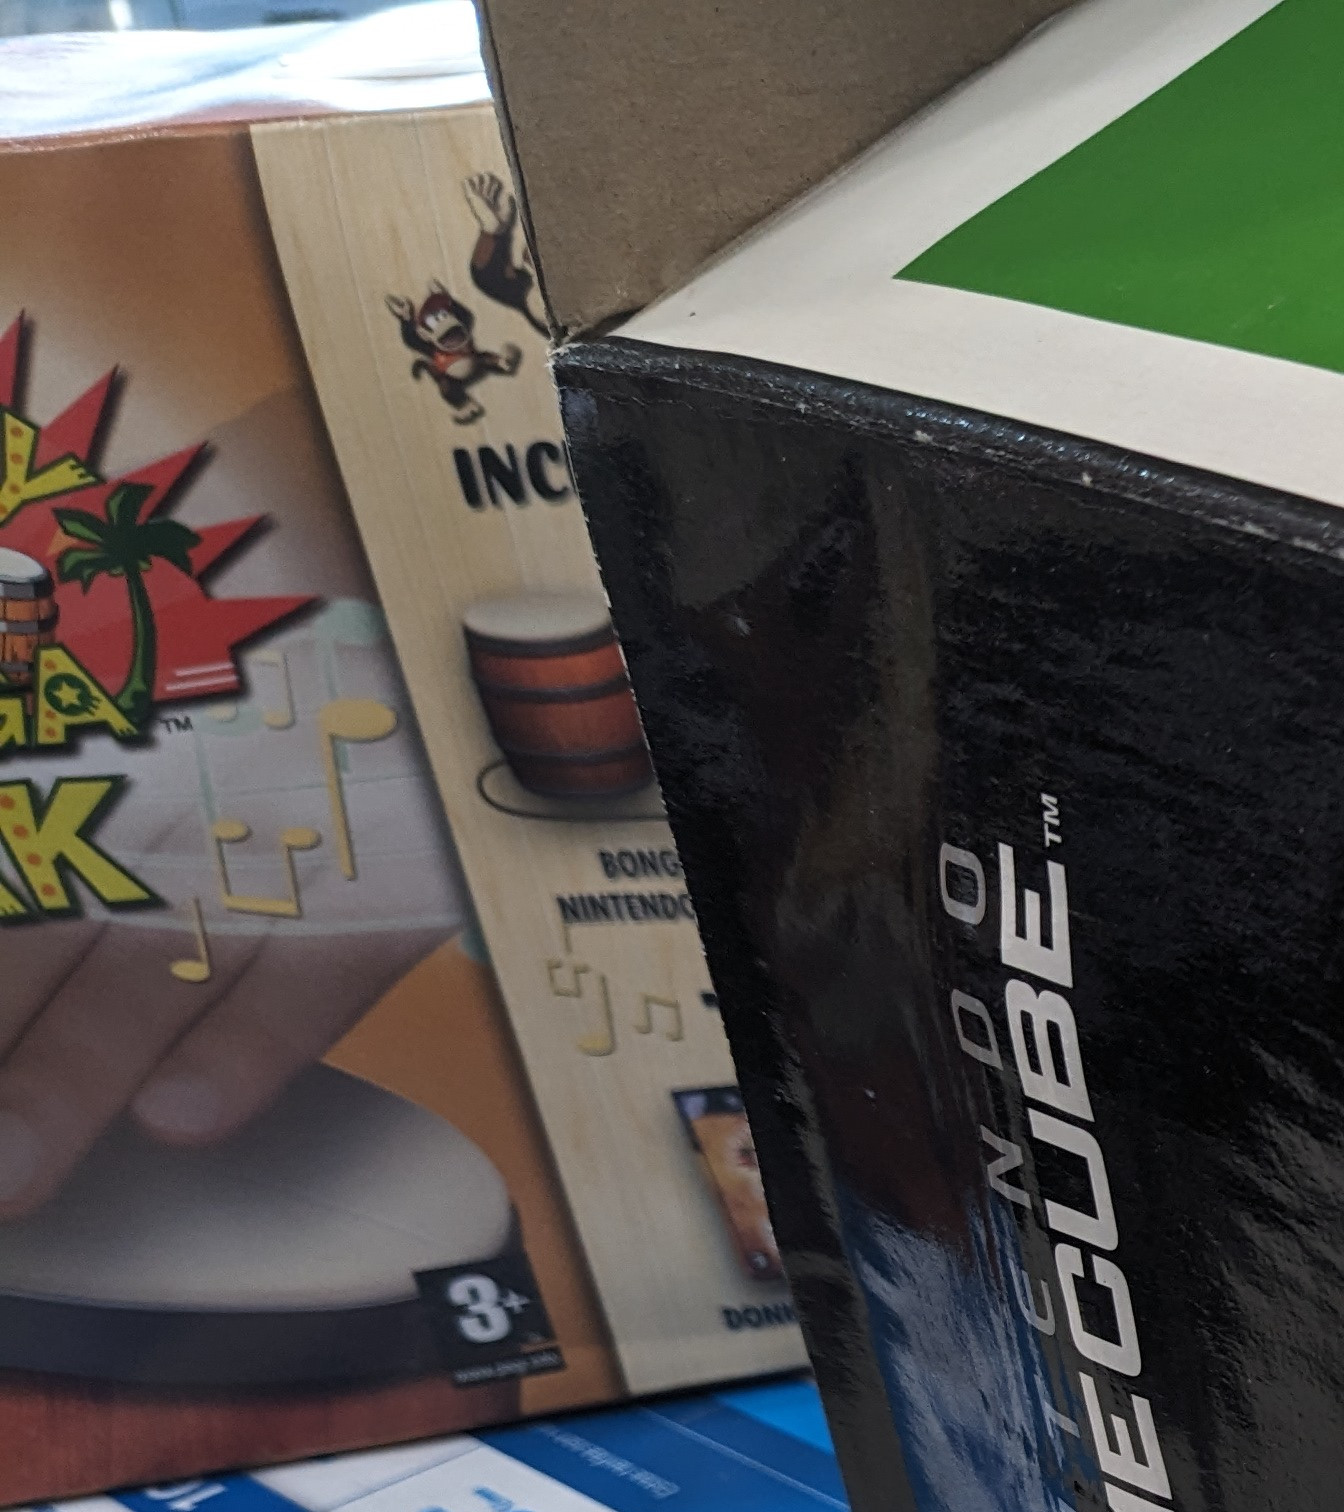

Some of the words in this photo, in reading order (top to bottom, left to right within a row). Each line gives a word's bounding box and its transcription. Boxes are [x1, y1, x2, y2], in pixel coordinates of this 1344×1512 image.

[452, 440, 575, 508] INC
[598, 848, 683, 881] BONG
[448, 1273, 530, 1344] 3+
